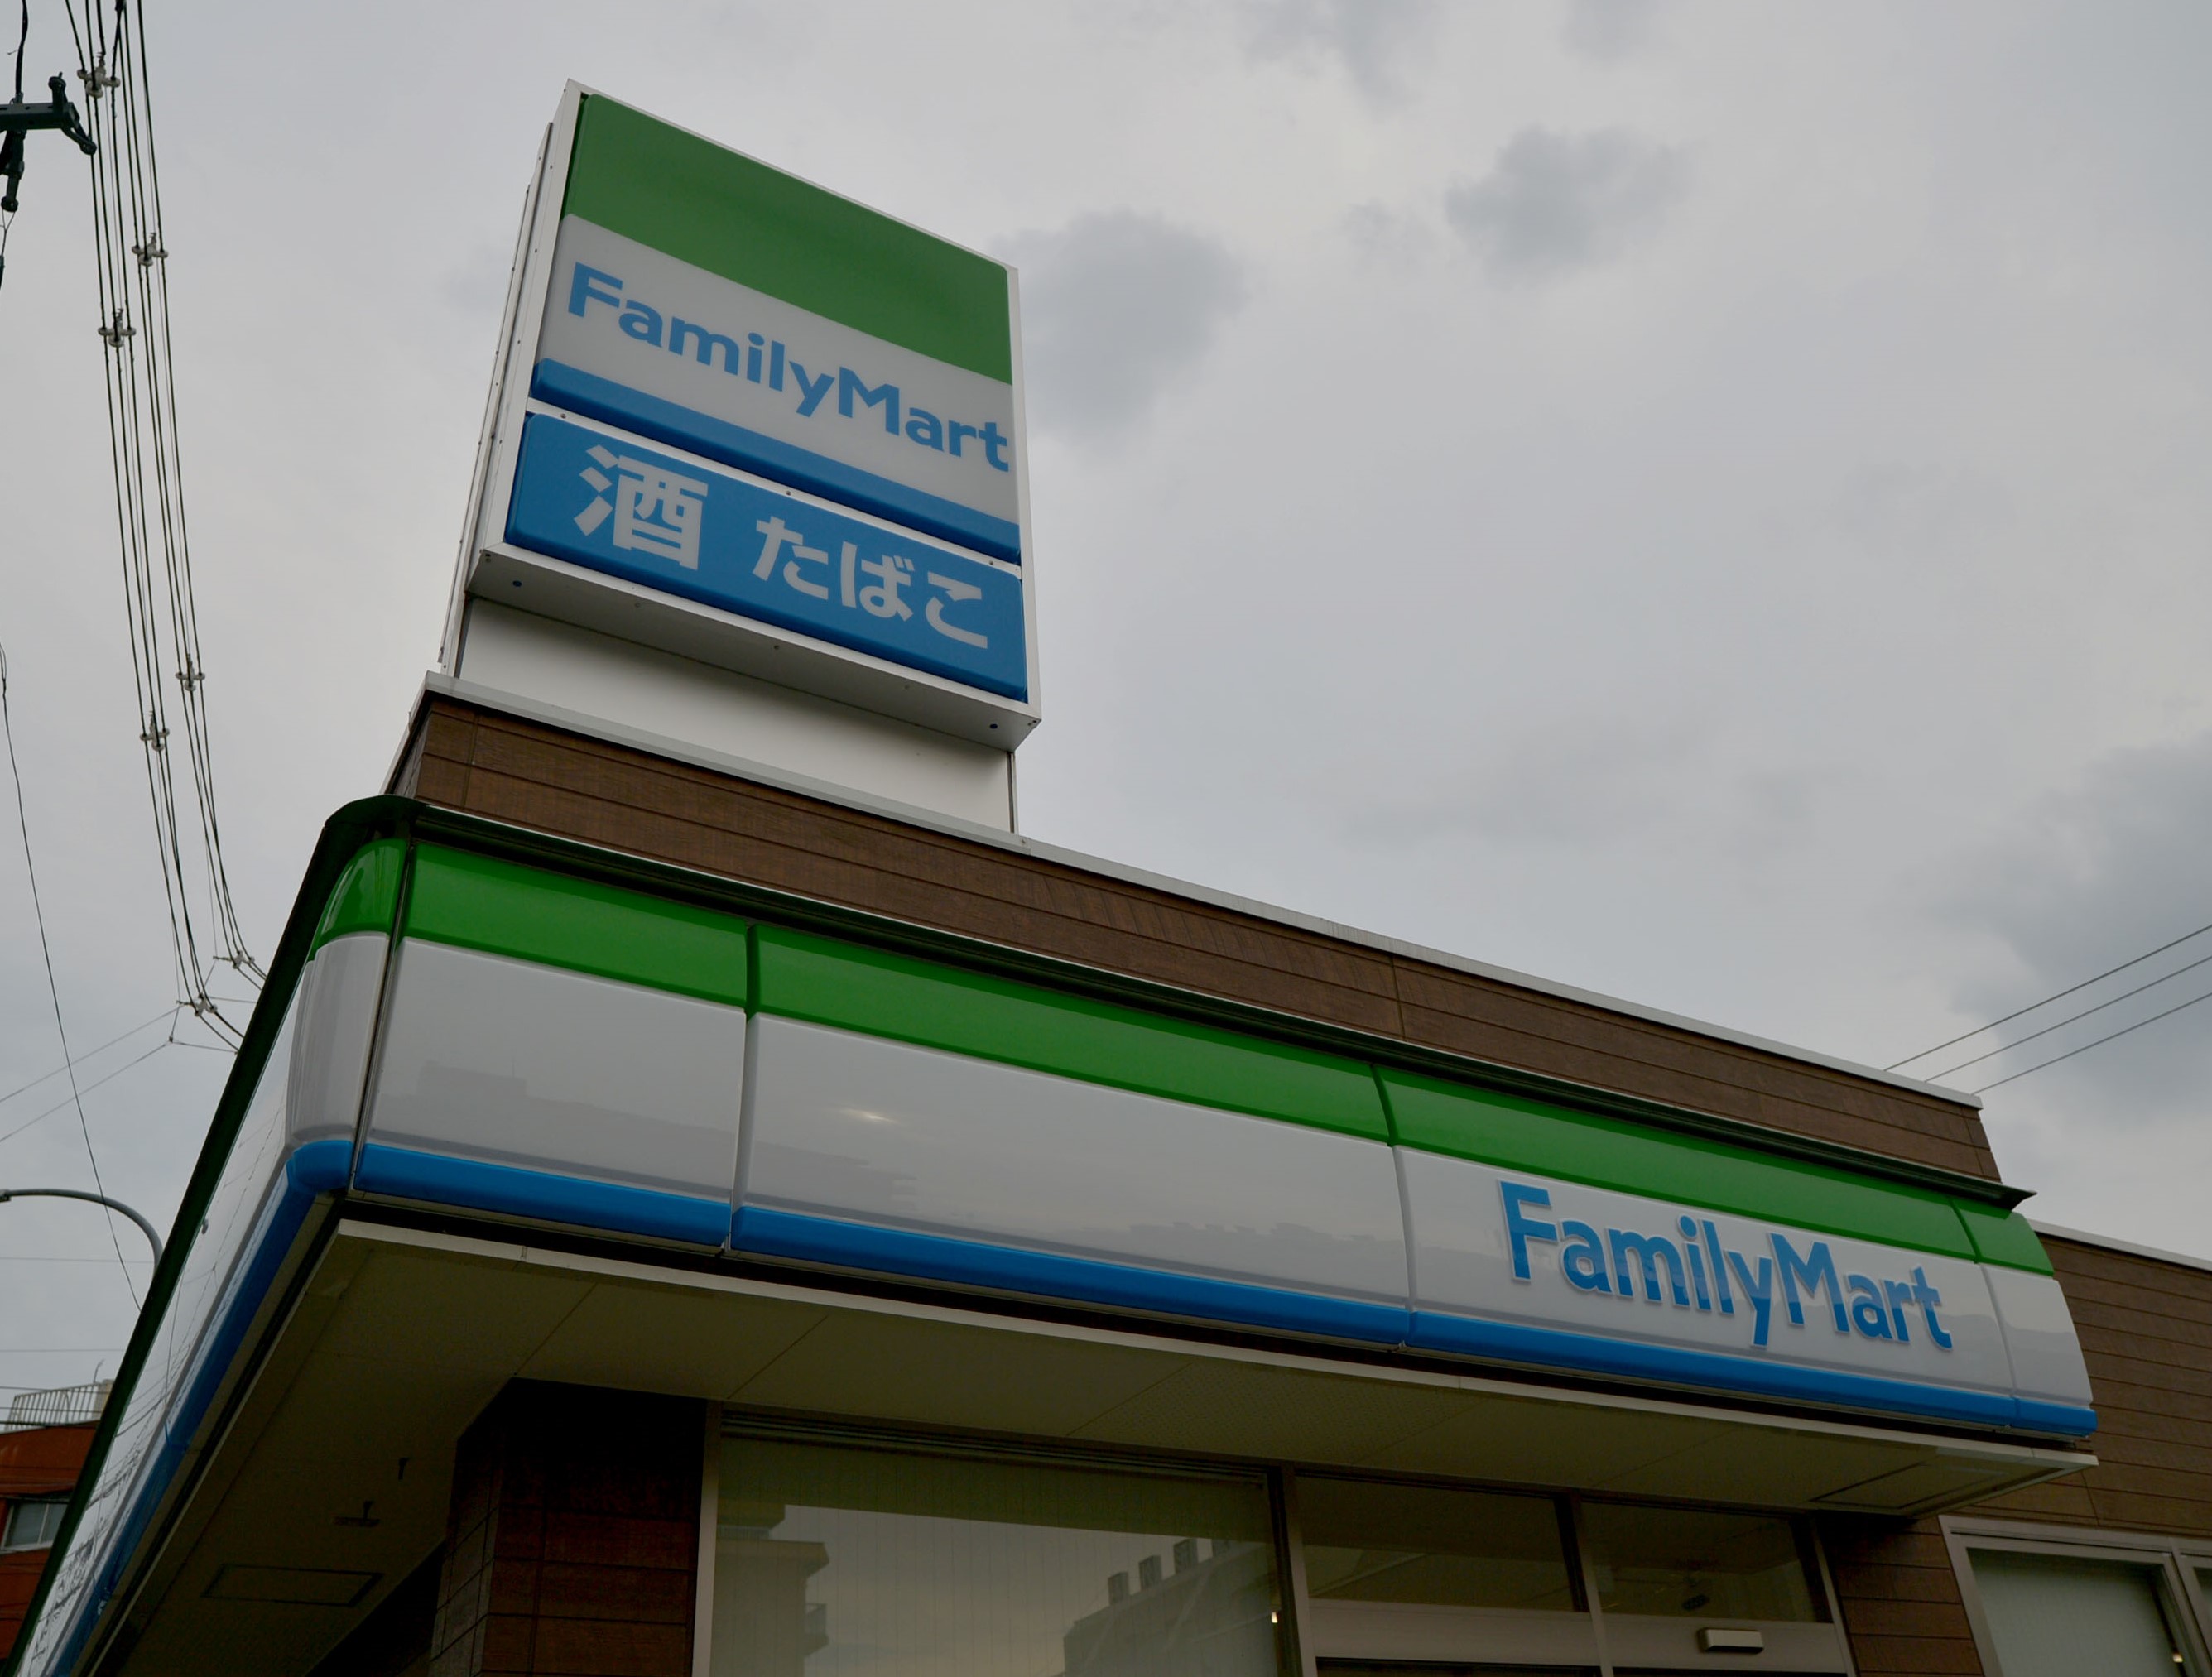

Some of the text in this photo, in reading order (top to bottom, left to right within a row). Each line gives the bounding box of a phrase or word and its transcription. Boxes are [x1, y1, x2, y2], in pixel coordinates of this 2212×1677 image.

[568, 261, 1009, 473] FamilyMart
[574, 444, 988, 649] 酒 たばこ
[1499, 1180, 1952, 1349] FamilyMart
